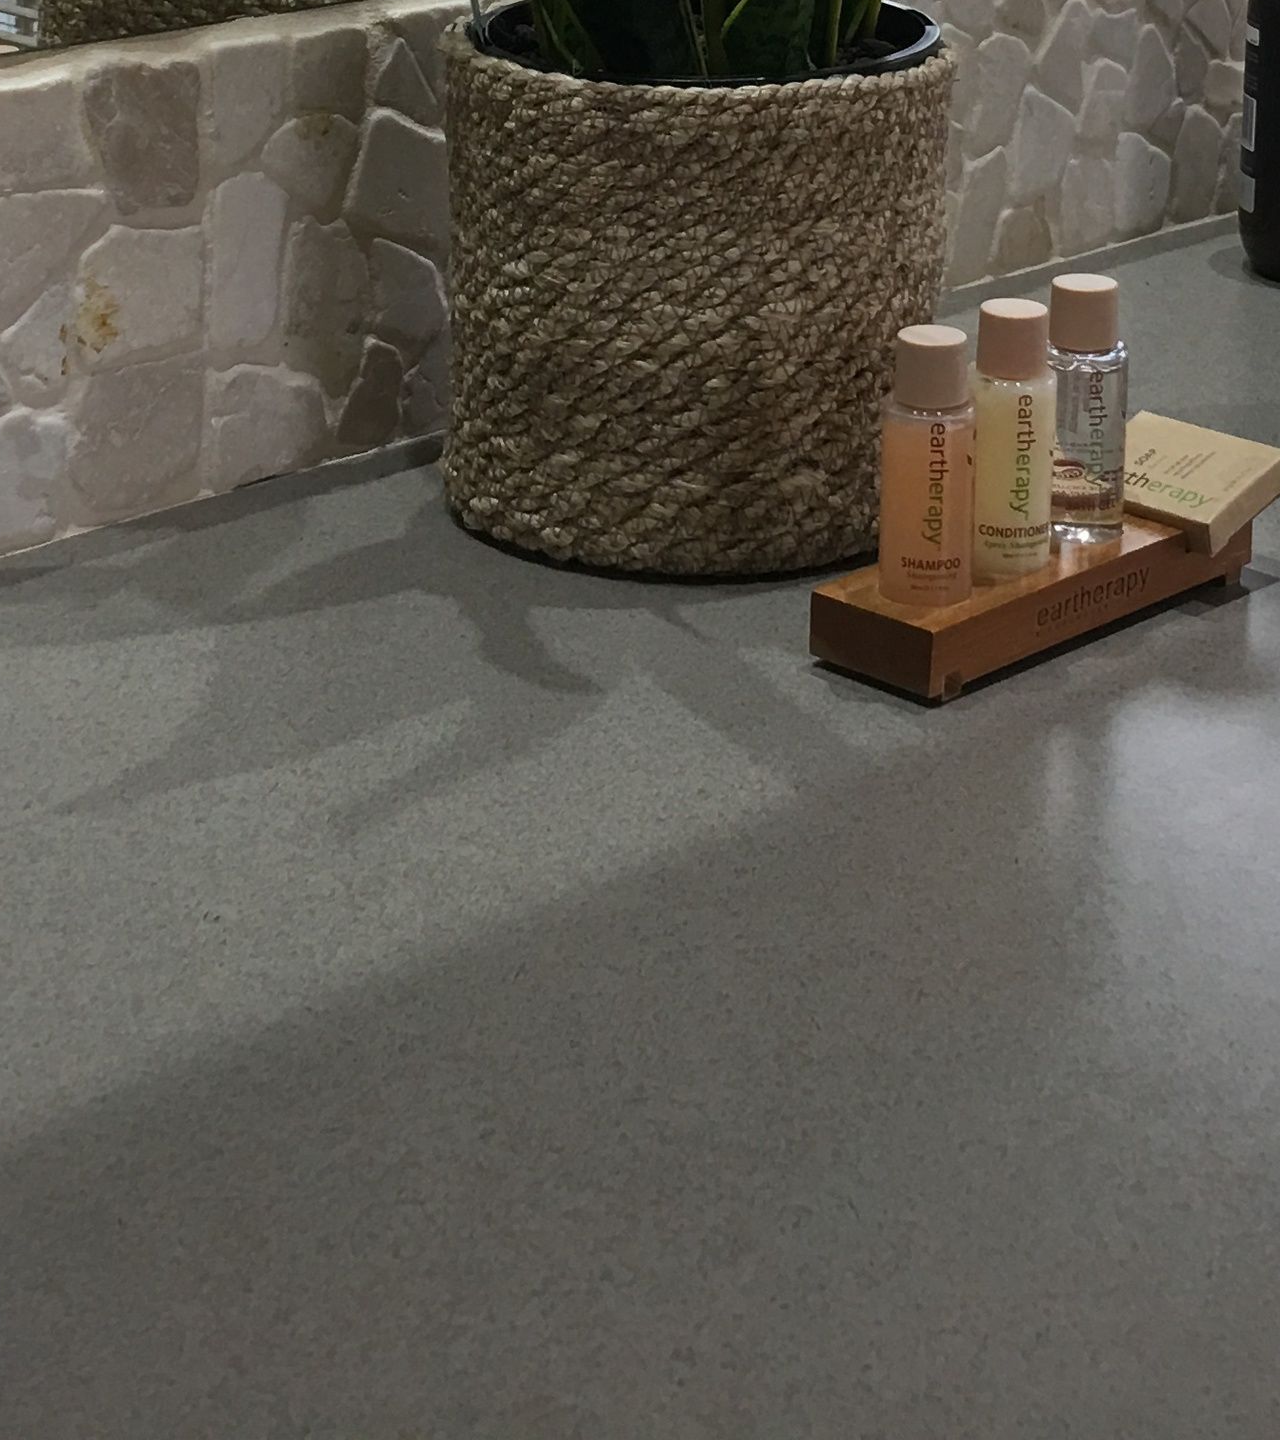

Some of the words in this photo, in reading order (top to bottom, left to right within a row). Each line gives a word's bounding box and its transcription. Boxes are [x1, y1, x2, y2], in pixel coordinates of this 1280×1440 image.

[921, 421, 946, 550] eartherapy
[1009, 393, 1034, 521] eartherapy
[1085, 370, 1109, 487] eartherapy
[900, 556, 961, 571] SHAMPOO
[1036, 565, 1151, 627] eartherapy
